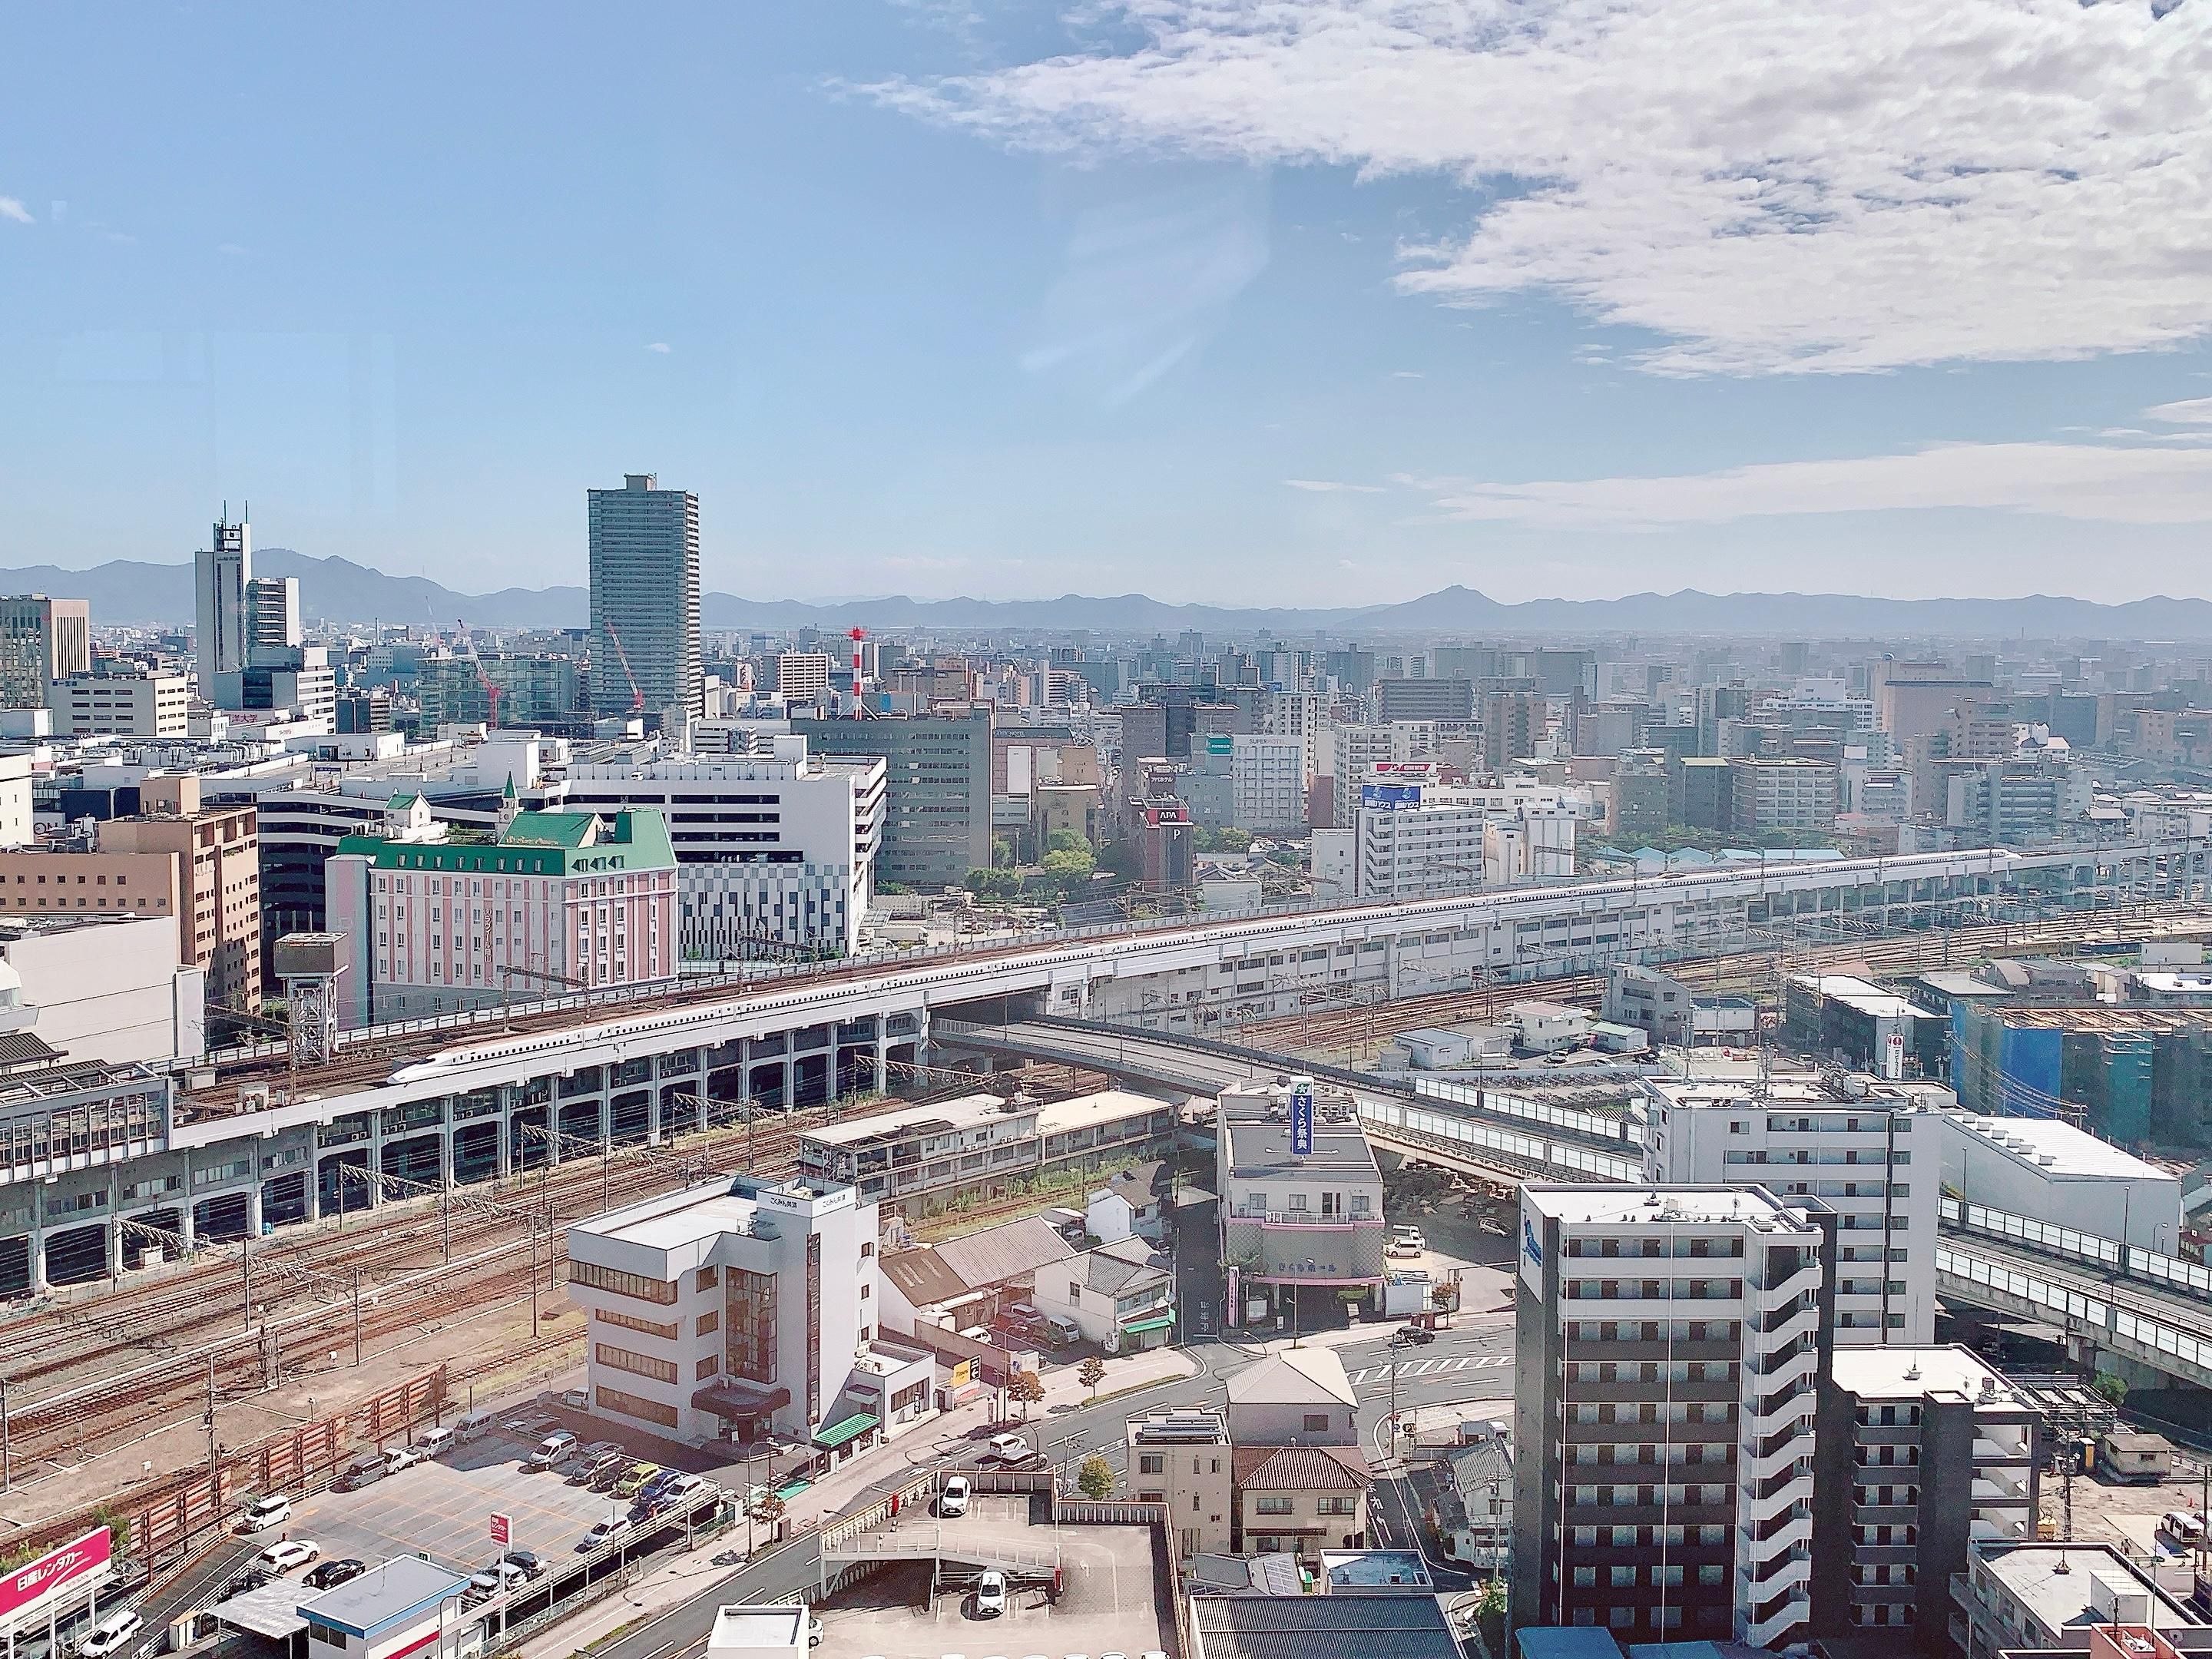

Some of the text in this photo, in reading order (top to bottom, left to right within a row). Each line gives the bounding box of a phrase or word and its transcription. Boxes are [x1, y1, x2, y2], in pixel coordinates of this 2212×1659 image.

[1174, 829, 1181, 840] P
[1297, 1095, 1308, 1150] さくら祭典
[17, 1550, 84, 1592] 日産レンタカー
[65, 1573, 90, 1588] NISSAN
